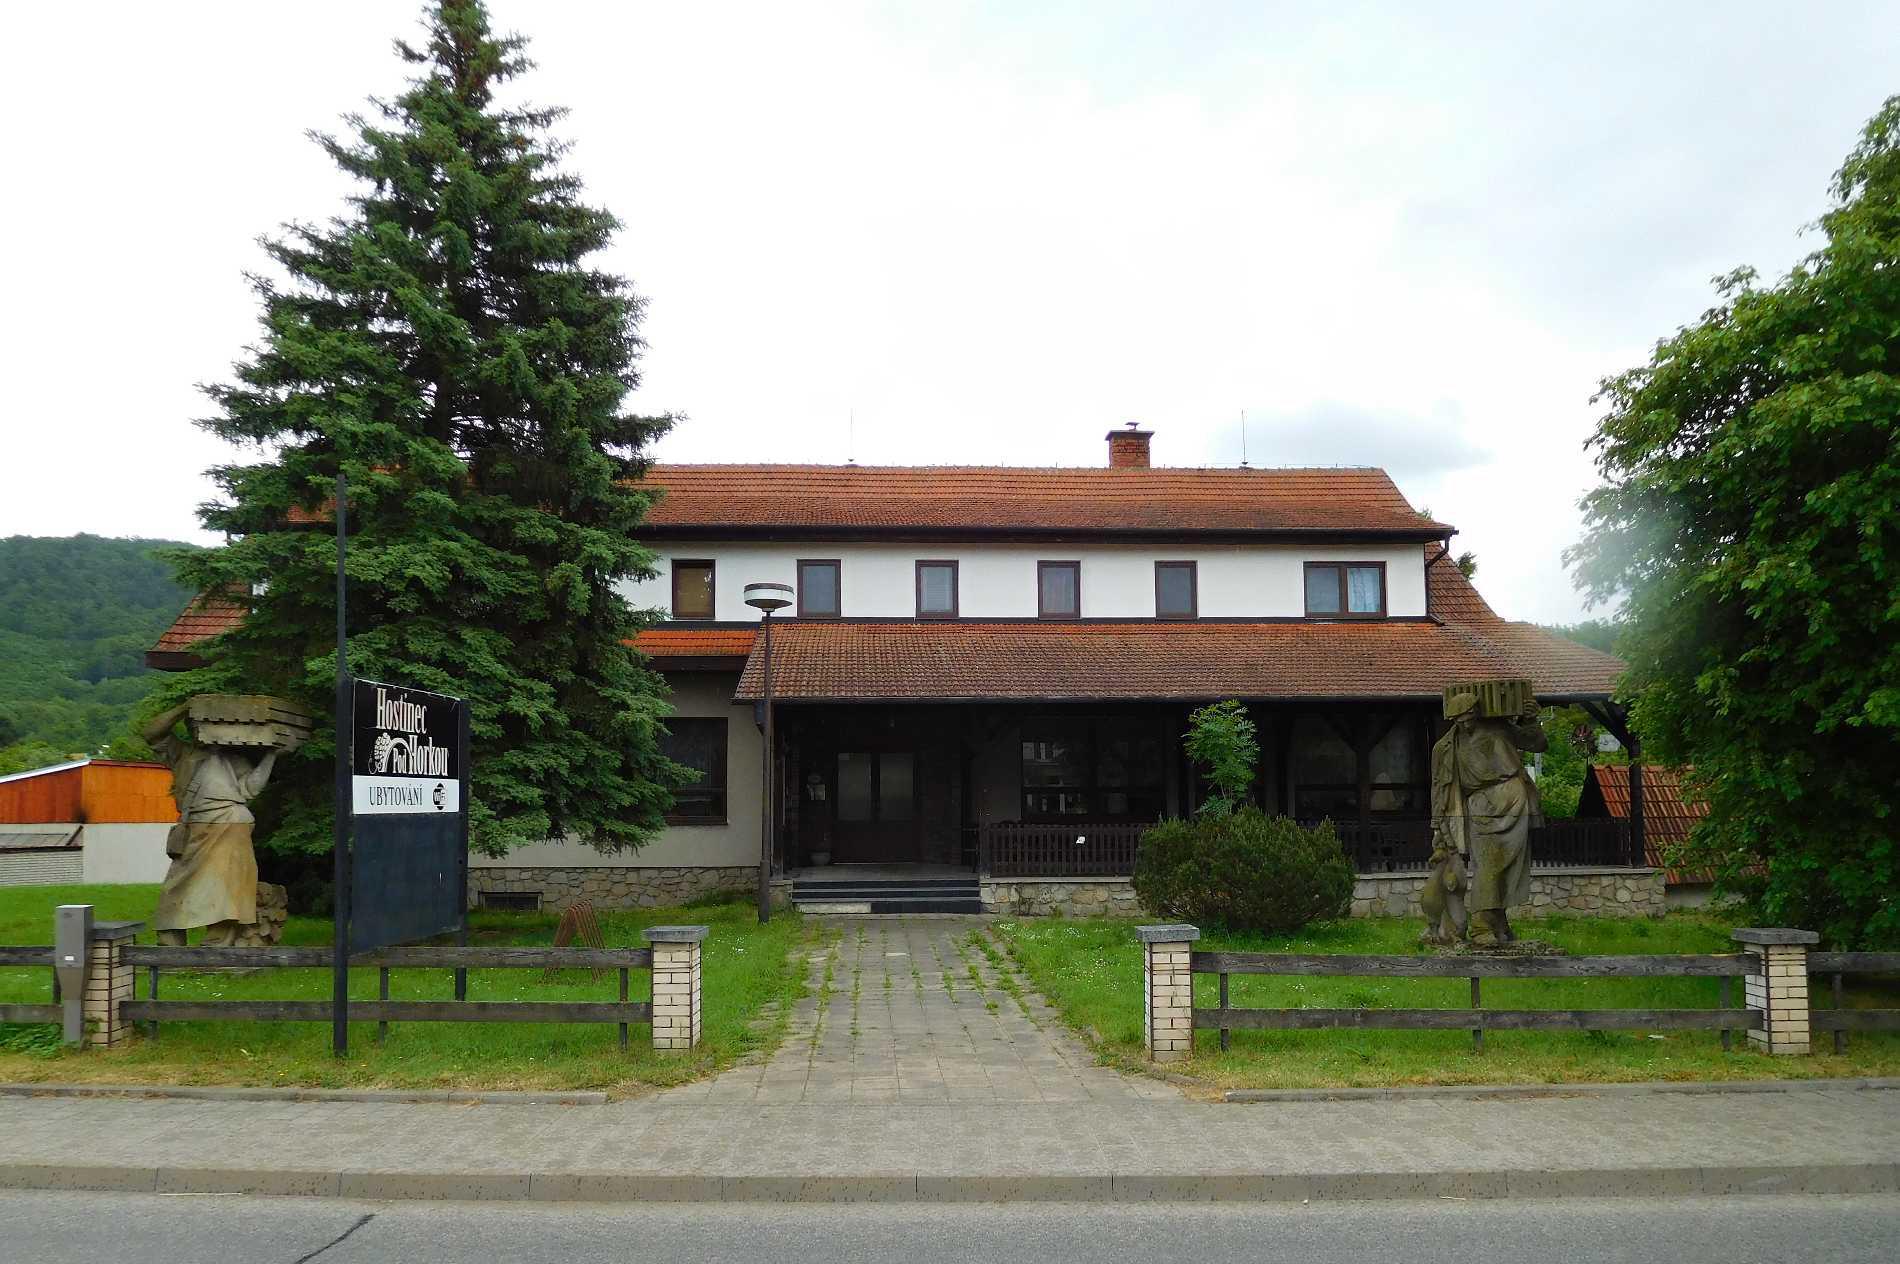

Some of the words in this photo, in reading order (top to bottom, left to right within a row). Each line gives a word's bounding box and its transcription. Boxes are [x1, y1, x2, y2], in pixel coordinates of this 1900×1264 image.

[376, 688, 427, 734] Hostinec
[392, 747, 407, 774] Pod
[408, 734, 449, 776] Horkou
[369, 784, 423, 806] UBYTOVÁNÍ
